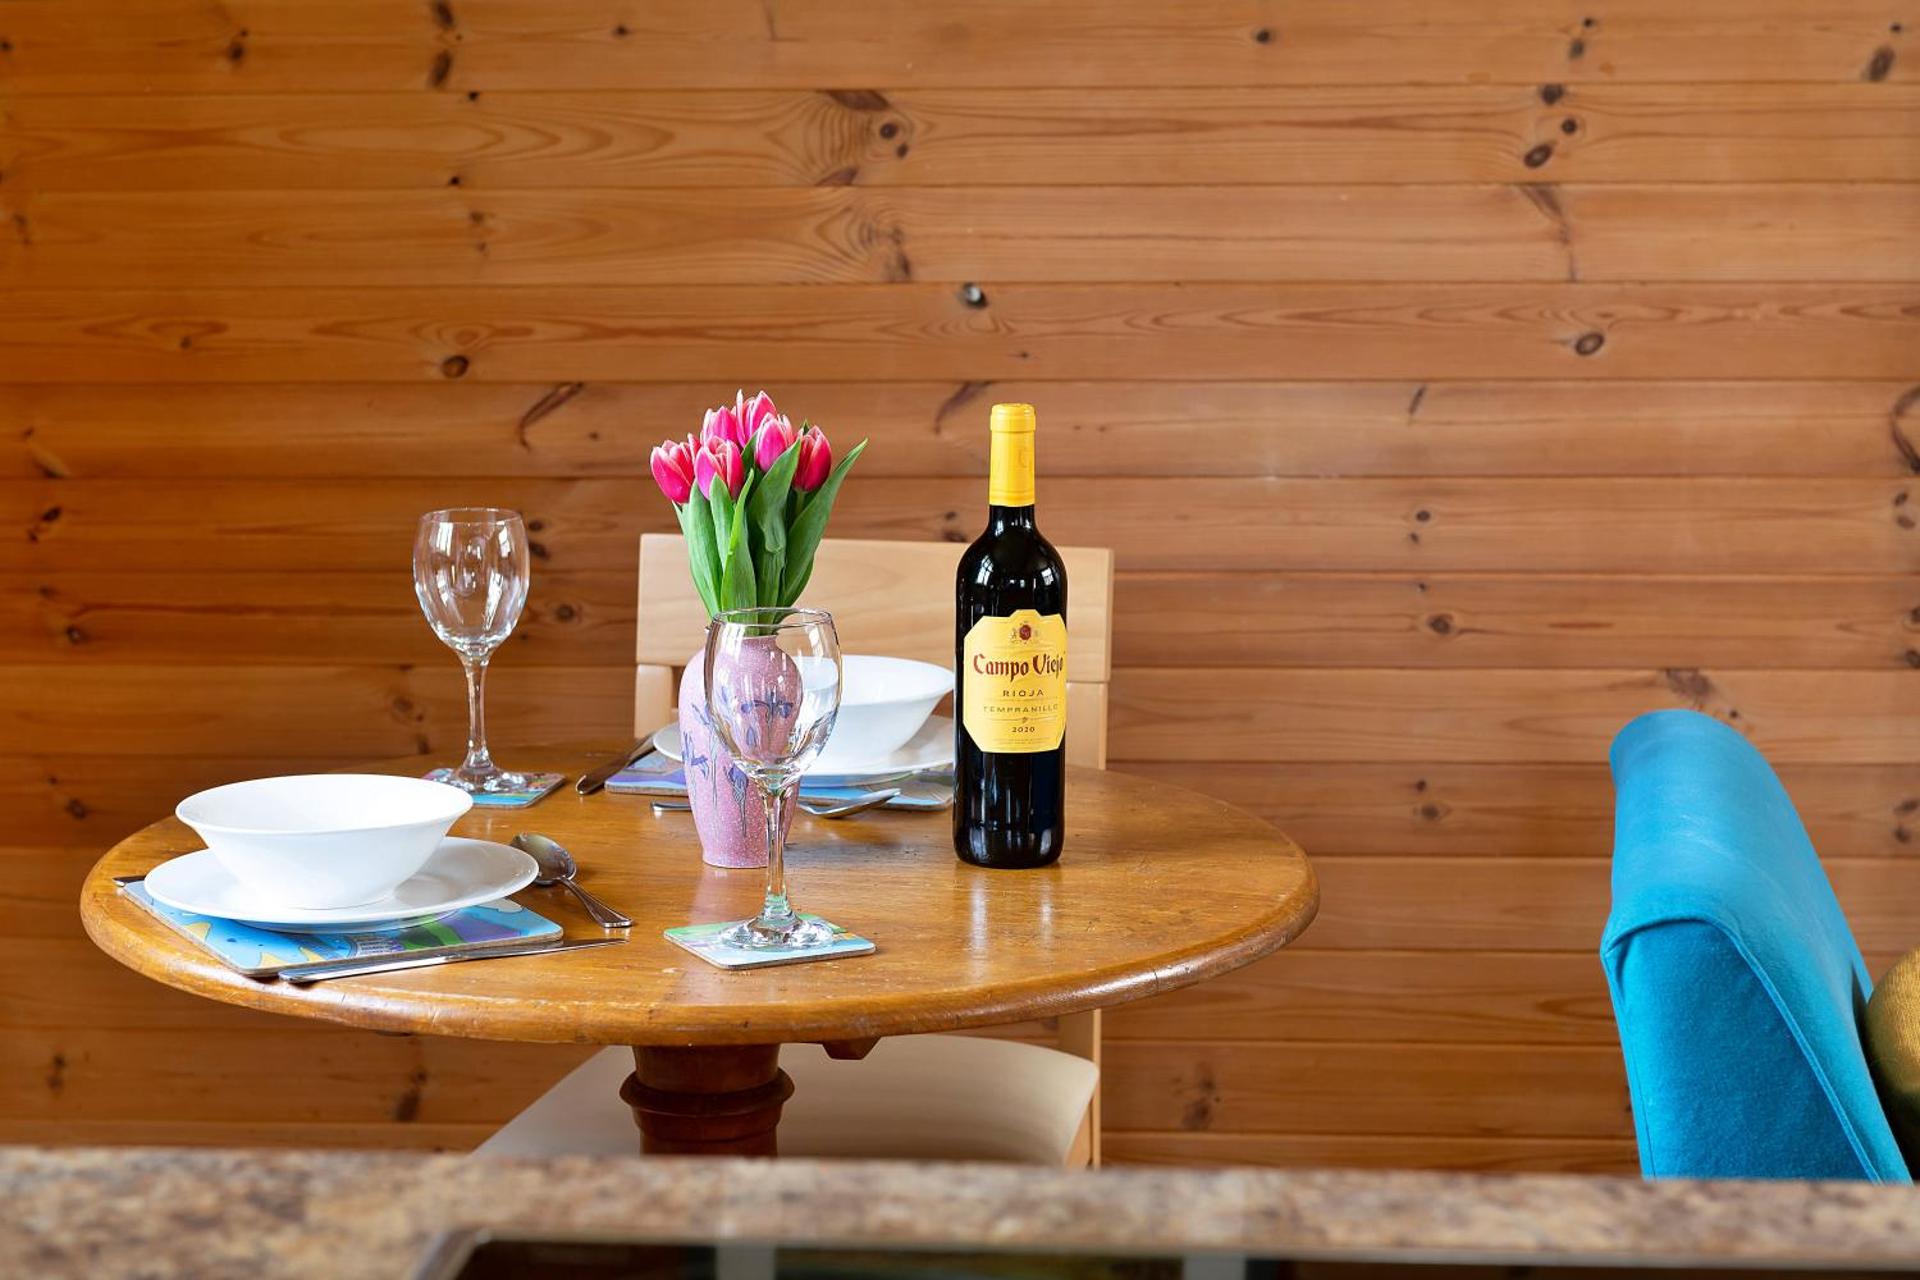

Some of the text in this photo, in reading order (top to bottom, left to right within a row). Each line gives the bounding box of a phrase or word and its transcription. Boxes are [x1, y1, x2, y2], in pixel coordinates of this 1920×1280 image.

[973, 653, 1029, 682] Campo
[1003, 689, 1044, 697] RIOJA
[983, 703, 1058, 713] TEMPRANILLO
